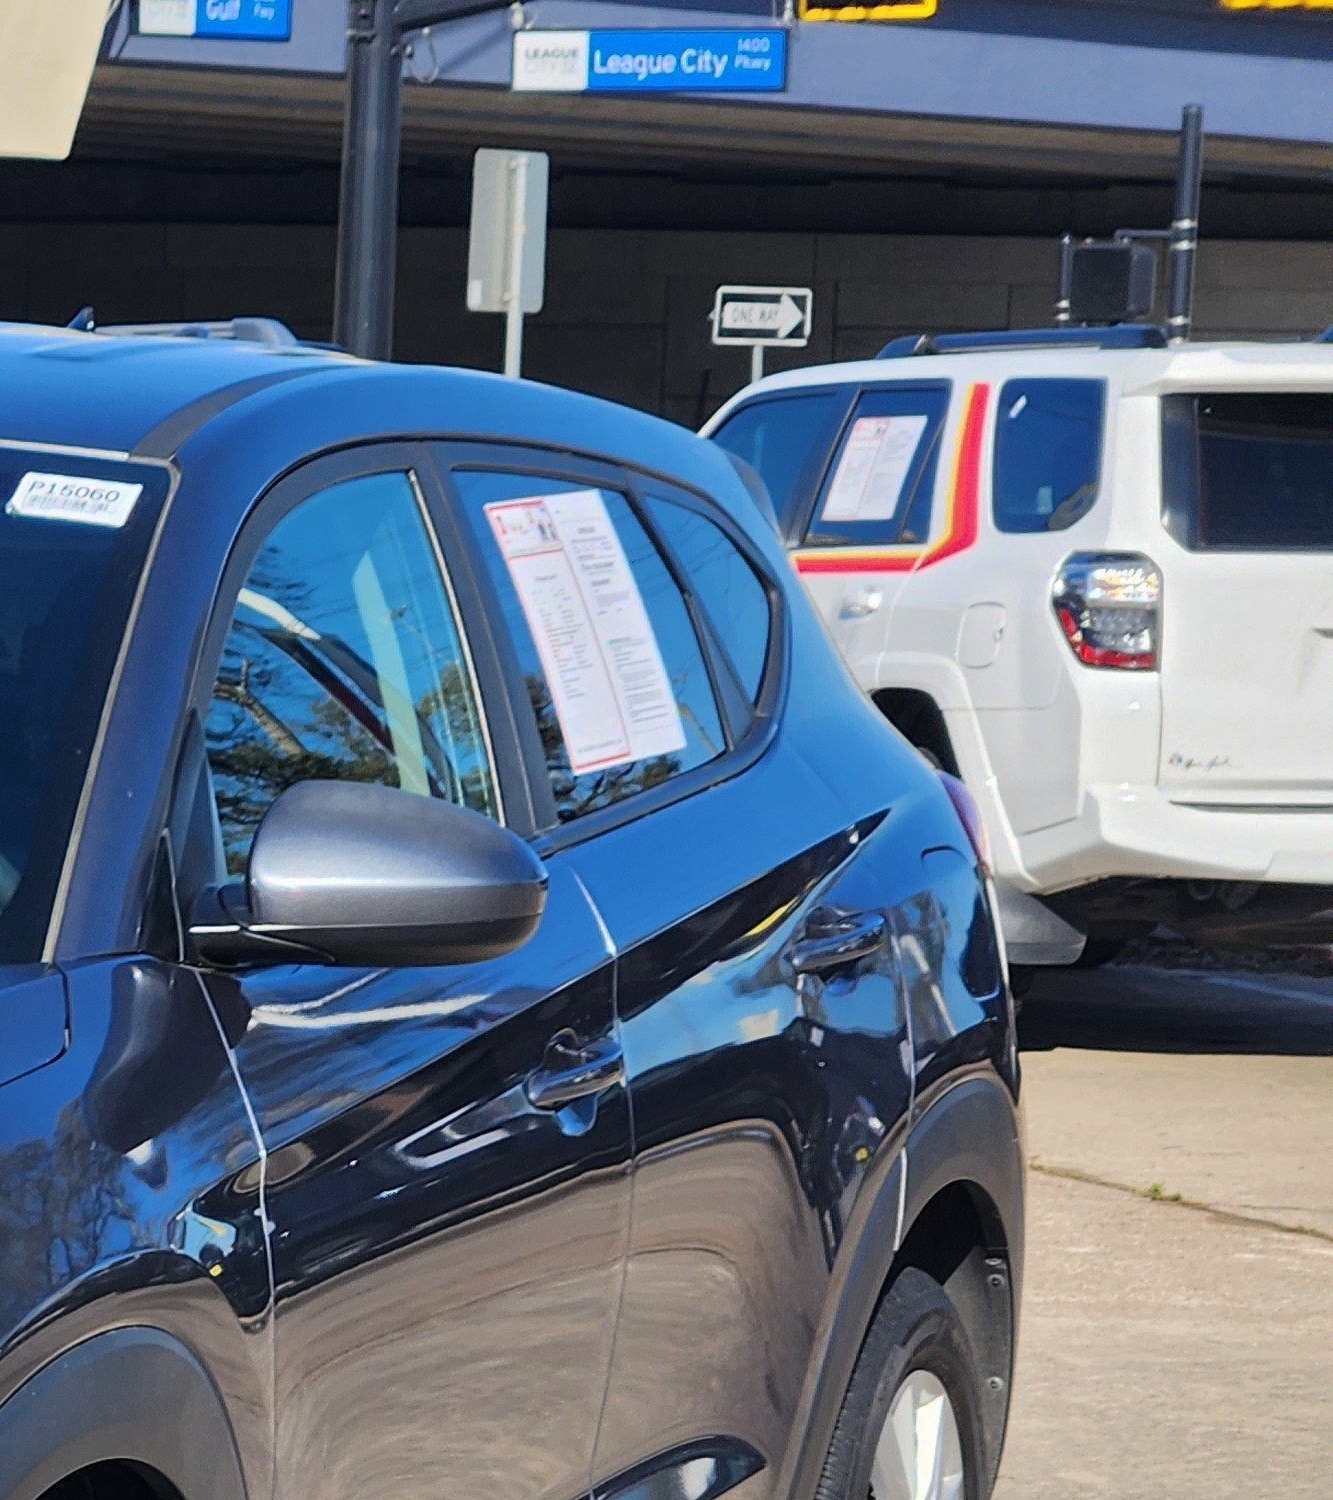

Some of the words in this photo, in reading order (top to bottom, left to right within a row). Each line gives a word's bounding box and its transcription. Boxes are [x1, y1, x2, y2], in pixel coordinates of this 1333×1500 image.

[594, 49, 676, 80] League
[680, 48, 728, 78] City
[28, 480, 121, 502] P15060
